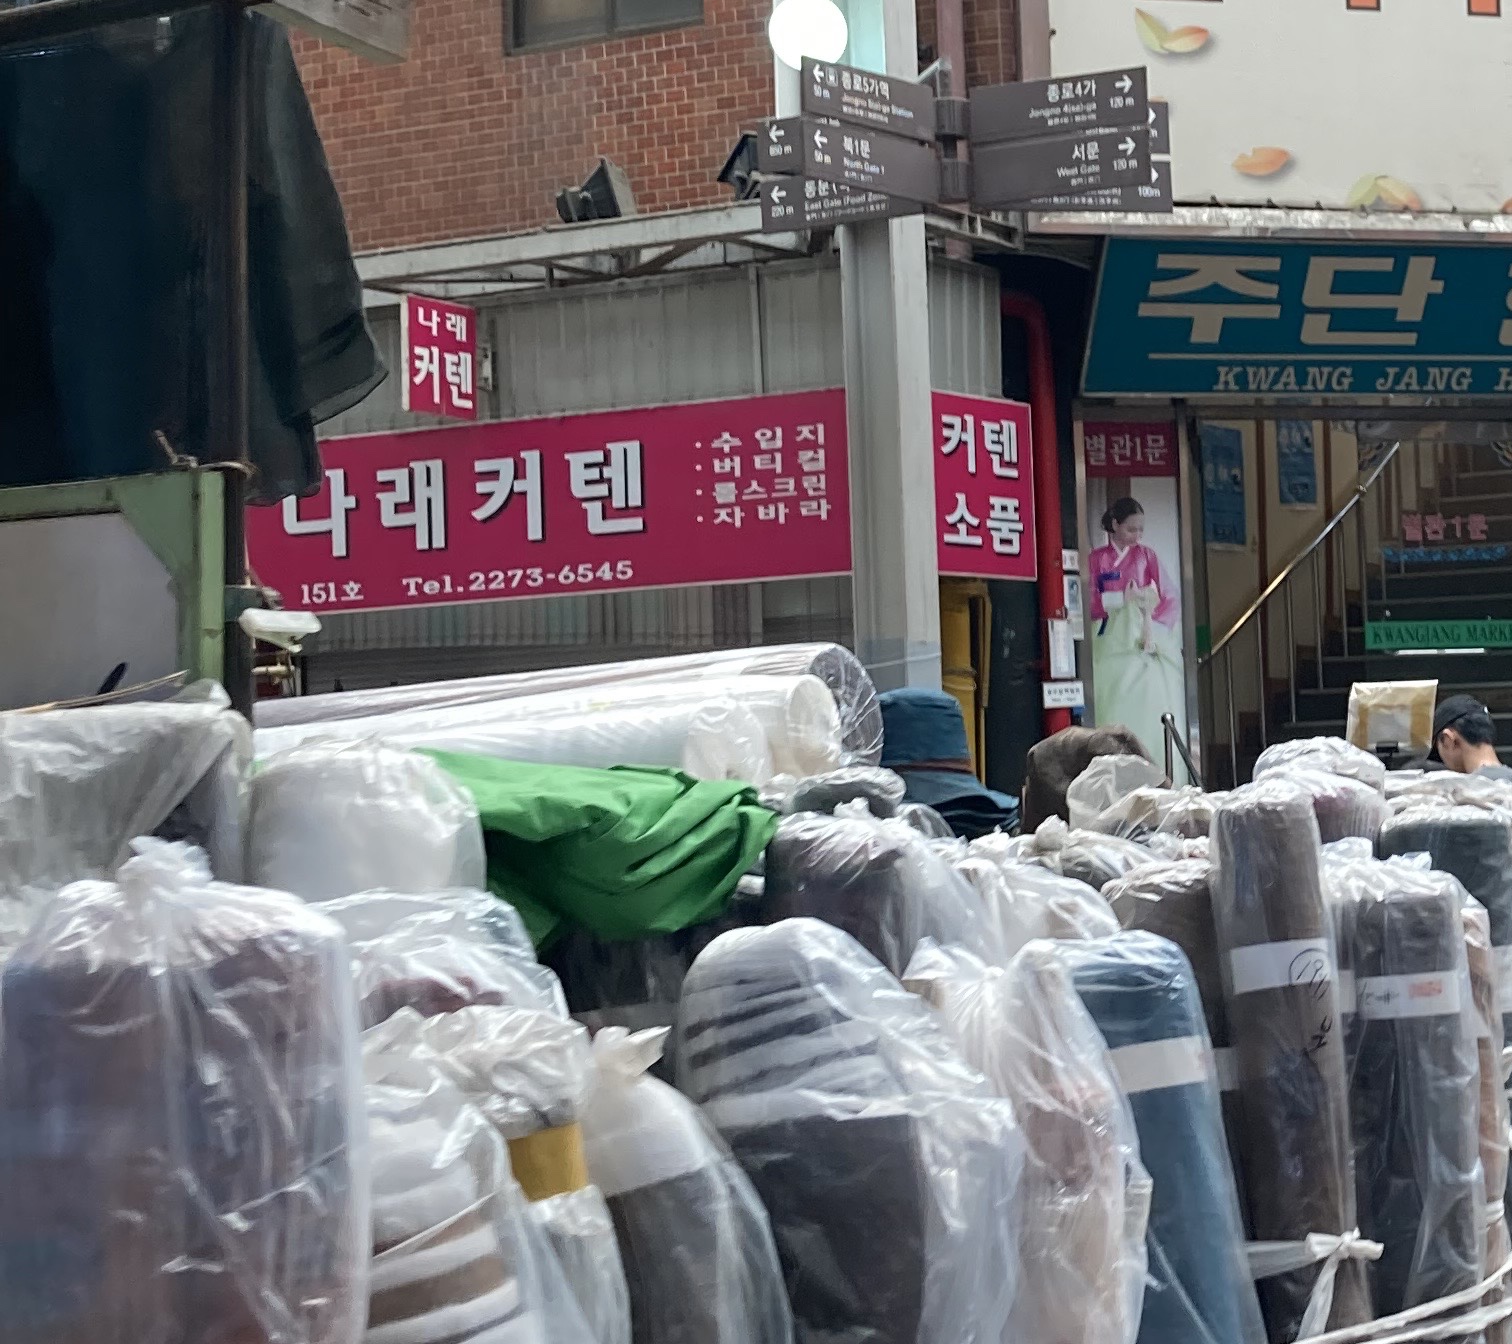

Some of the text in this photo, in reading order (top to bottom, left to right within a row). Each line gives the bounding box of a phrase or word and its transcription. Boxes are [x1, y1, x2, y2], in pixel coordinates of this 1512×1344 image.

[842, 70, 890, 101] 종로5가역
[1047, 79, 1097, 103] 종로4가
[1072, 140, 1100, 161] 서문
[1138, 253, 1445, 346] 주단
[417, 306, 467, 343] 나래
[413, 345, 473, 410] 커텐
[1212, 365, 1354, 392] KWANG
[1375, 365, 1473, 392] JANG
[941, 413, 1019, 479] 커텐
[1085, 433, 1169, 467] 별관1문
[713, 498, 831, 529] 자바라
[943, 492, 1024, 556] 소품
[301, 559, 635, 605] 151호 Tel.2273-6545
[1372, 624, 1462, 646] KWANGJANG
